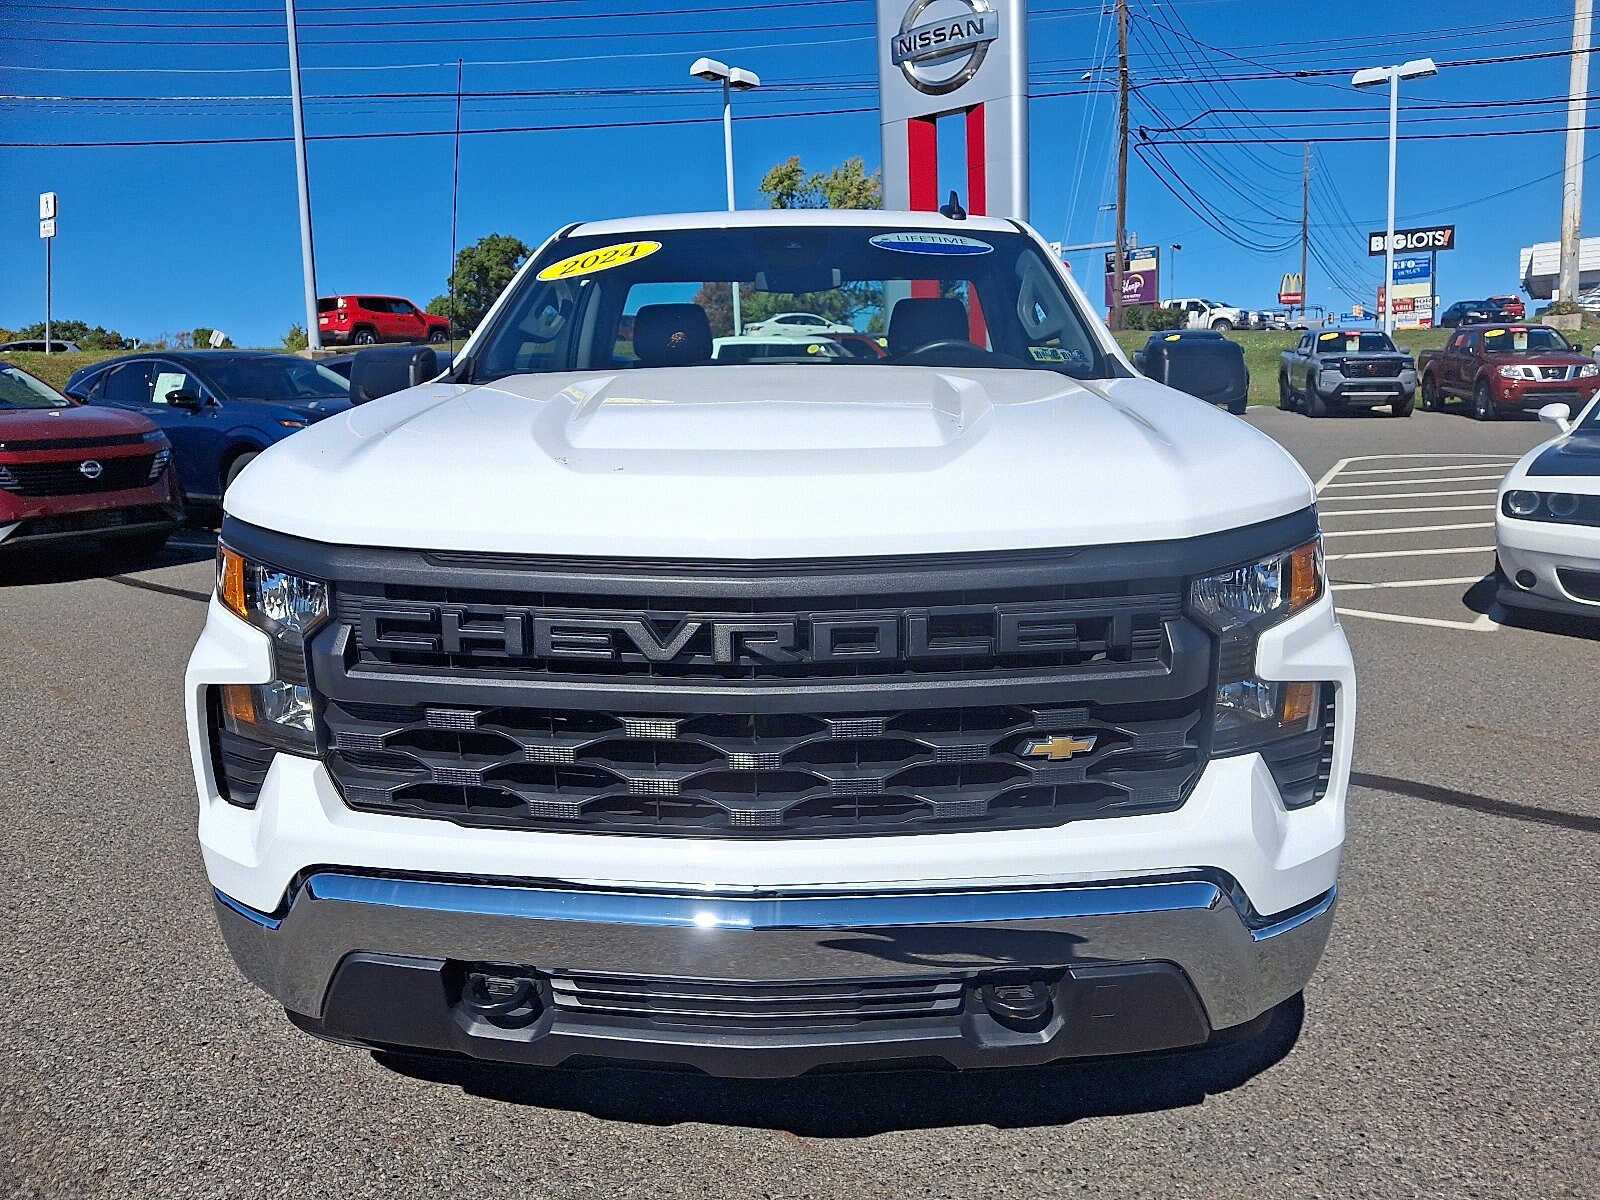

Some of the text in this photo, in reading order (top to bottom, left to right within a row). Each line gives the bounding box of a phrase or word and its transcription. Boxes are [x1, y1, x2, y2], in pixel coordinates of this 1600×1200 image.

[898, 17, 984, 57] NISSAN
[896, 235, 969, 245] LIFETIME
[559, 244, 640, 276] 2024
[359, 601, 1161, 665] CHEVROLET
